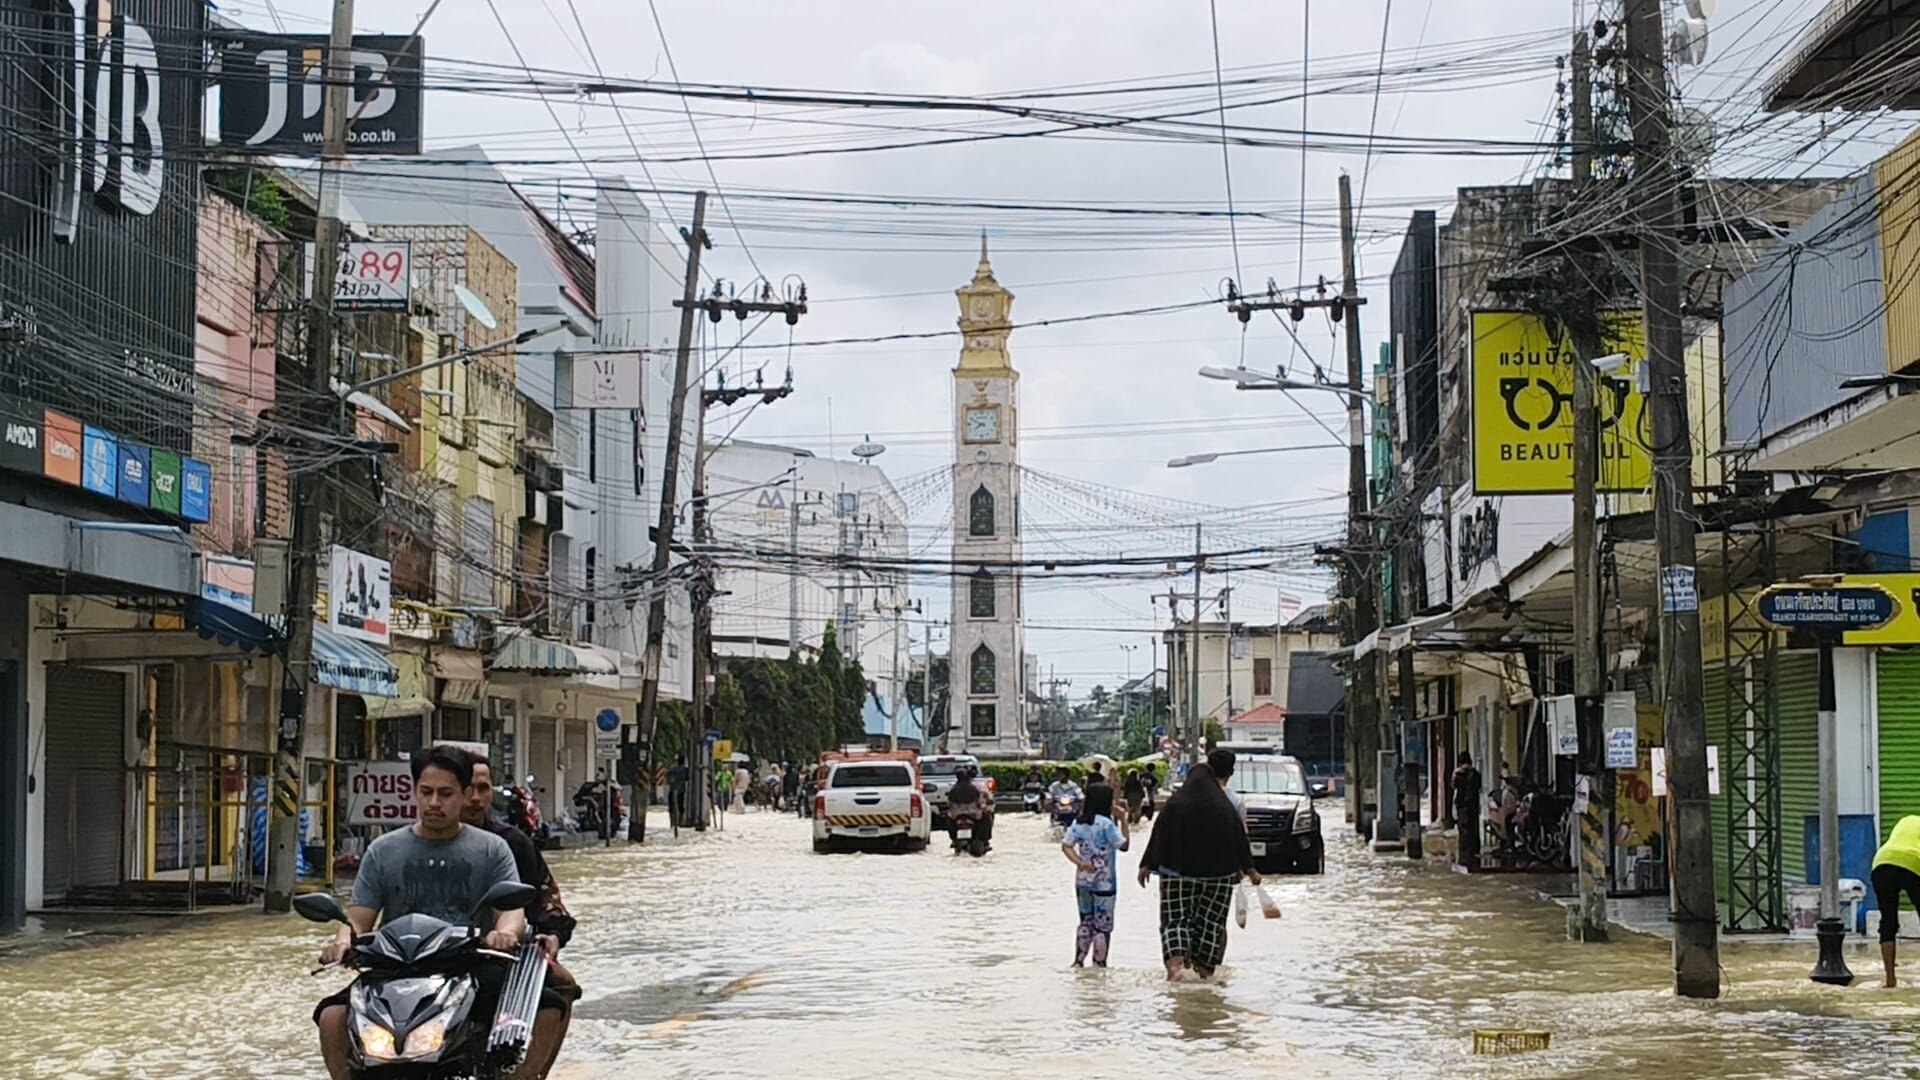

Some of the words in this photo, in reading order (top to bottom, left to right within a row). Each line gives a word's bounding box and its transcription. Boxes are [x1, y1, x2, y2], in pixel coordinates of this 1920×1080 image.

[360, 251, 403, 284] 89
[6, 422, 31, 447] AMD
[1500, 442, 1630, 461] BEAUTUL
[353, 769, 411, 801] ถ่ายรู
[363, 799, 417, 819] ด่วน
